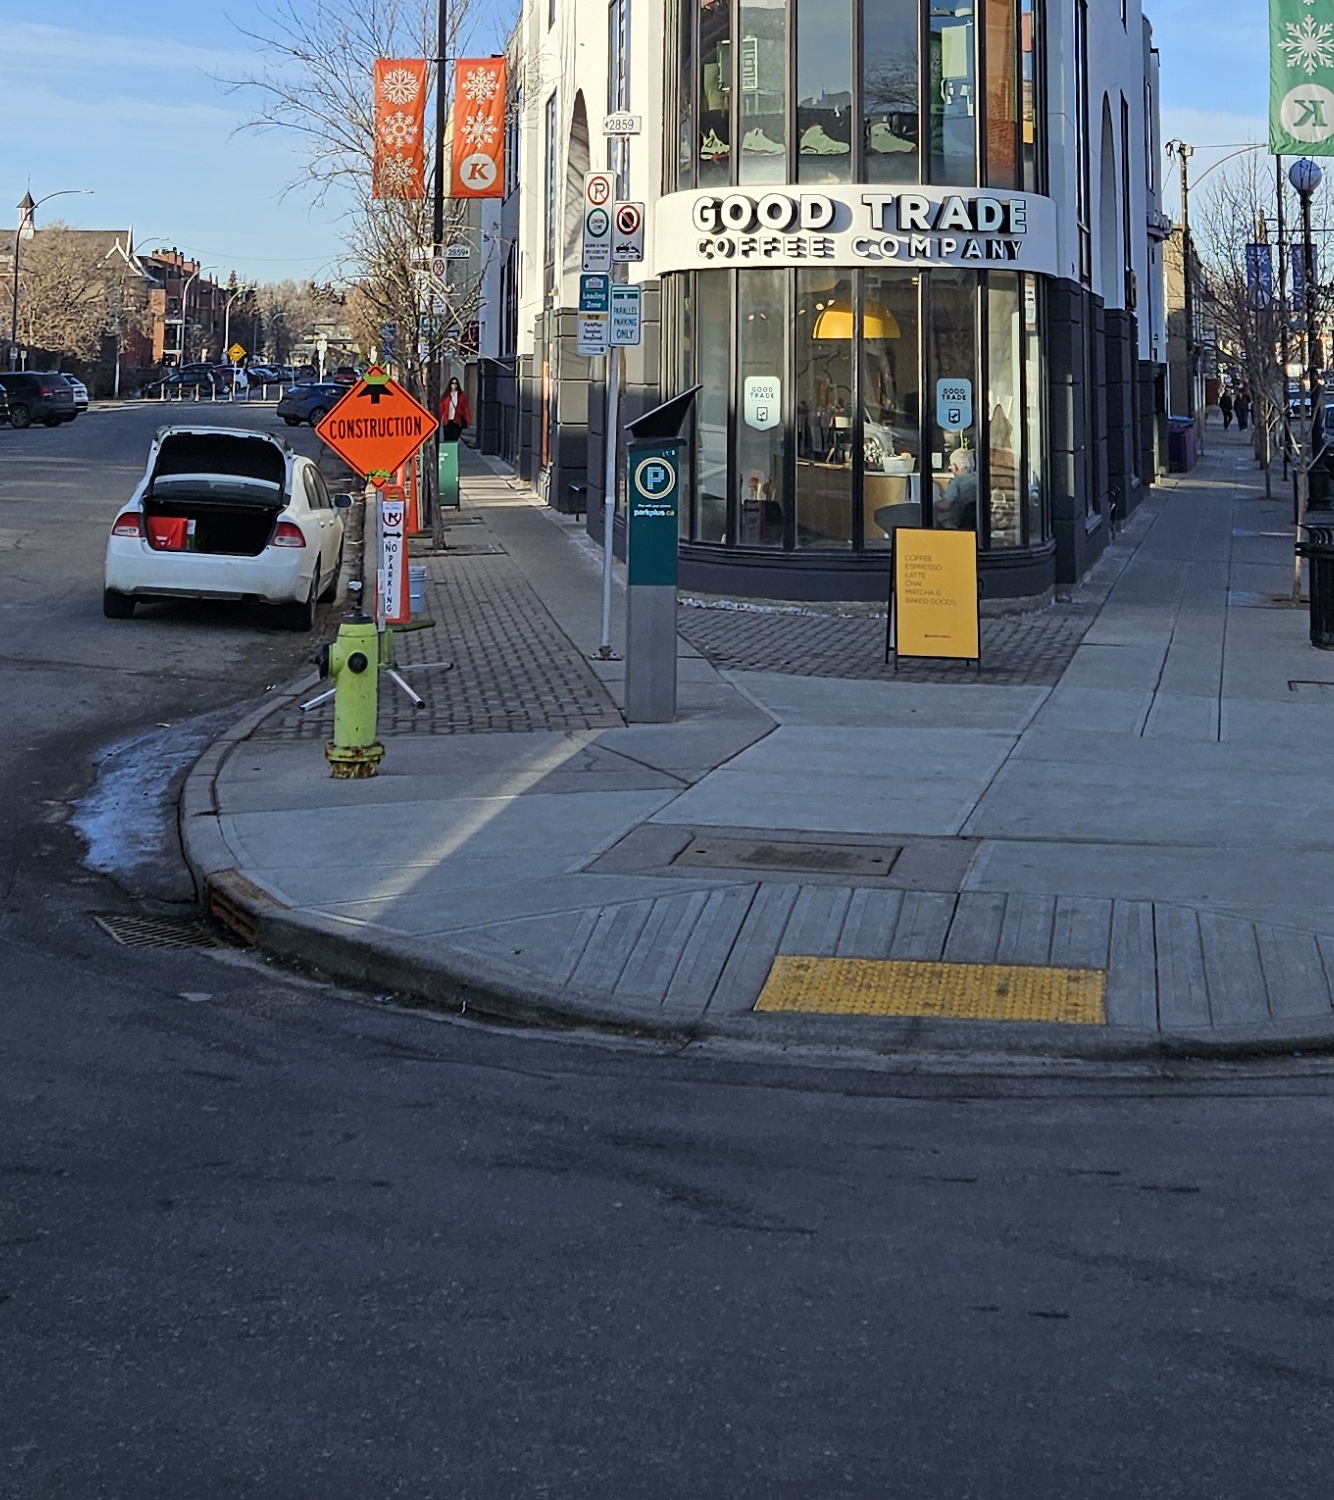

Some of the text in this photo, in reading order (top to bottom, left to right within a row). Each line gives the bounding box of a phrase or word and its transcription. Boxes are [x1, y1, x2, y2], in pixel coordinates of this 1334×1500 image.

[609, 119, 634, 131] 2859
[467, 163, 489, 180] K
[693, 193, 1028, 235] GOOD TRADE
[696, 234, 1023, 261] COFFEE COMPANY
[583, 292, 606, 301] Loading
[587, 301, 602, 309] Zone
[613, 307, 638, 316] PARALLEL
[613, 318, 637, 327] PARKING
[616, 329, 634, 339] ONLY
[329, 415, 422, 440] CONSTRUCTION
[385, 541, 398, 553] NO
[905, 554, 932, 562] COFFEE
[905, 562, 943, 571] ESPRESSO
[905, 571, 926, 579] LATTE
[905, 588, 934, 596] MATCHA
[905, 597, 957, 606] BAKED GOODS
